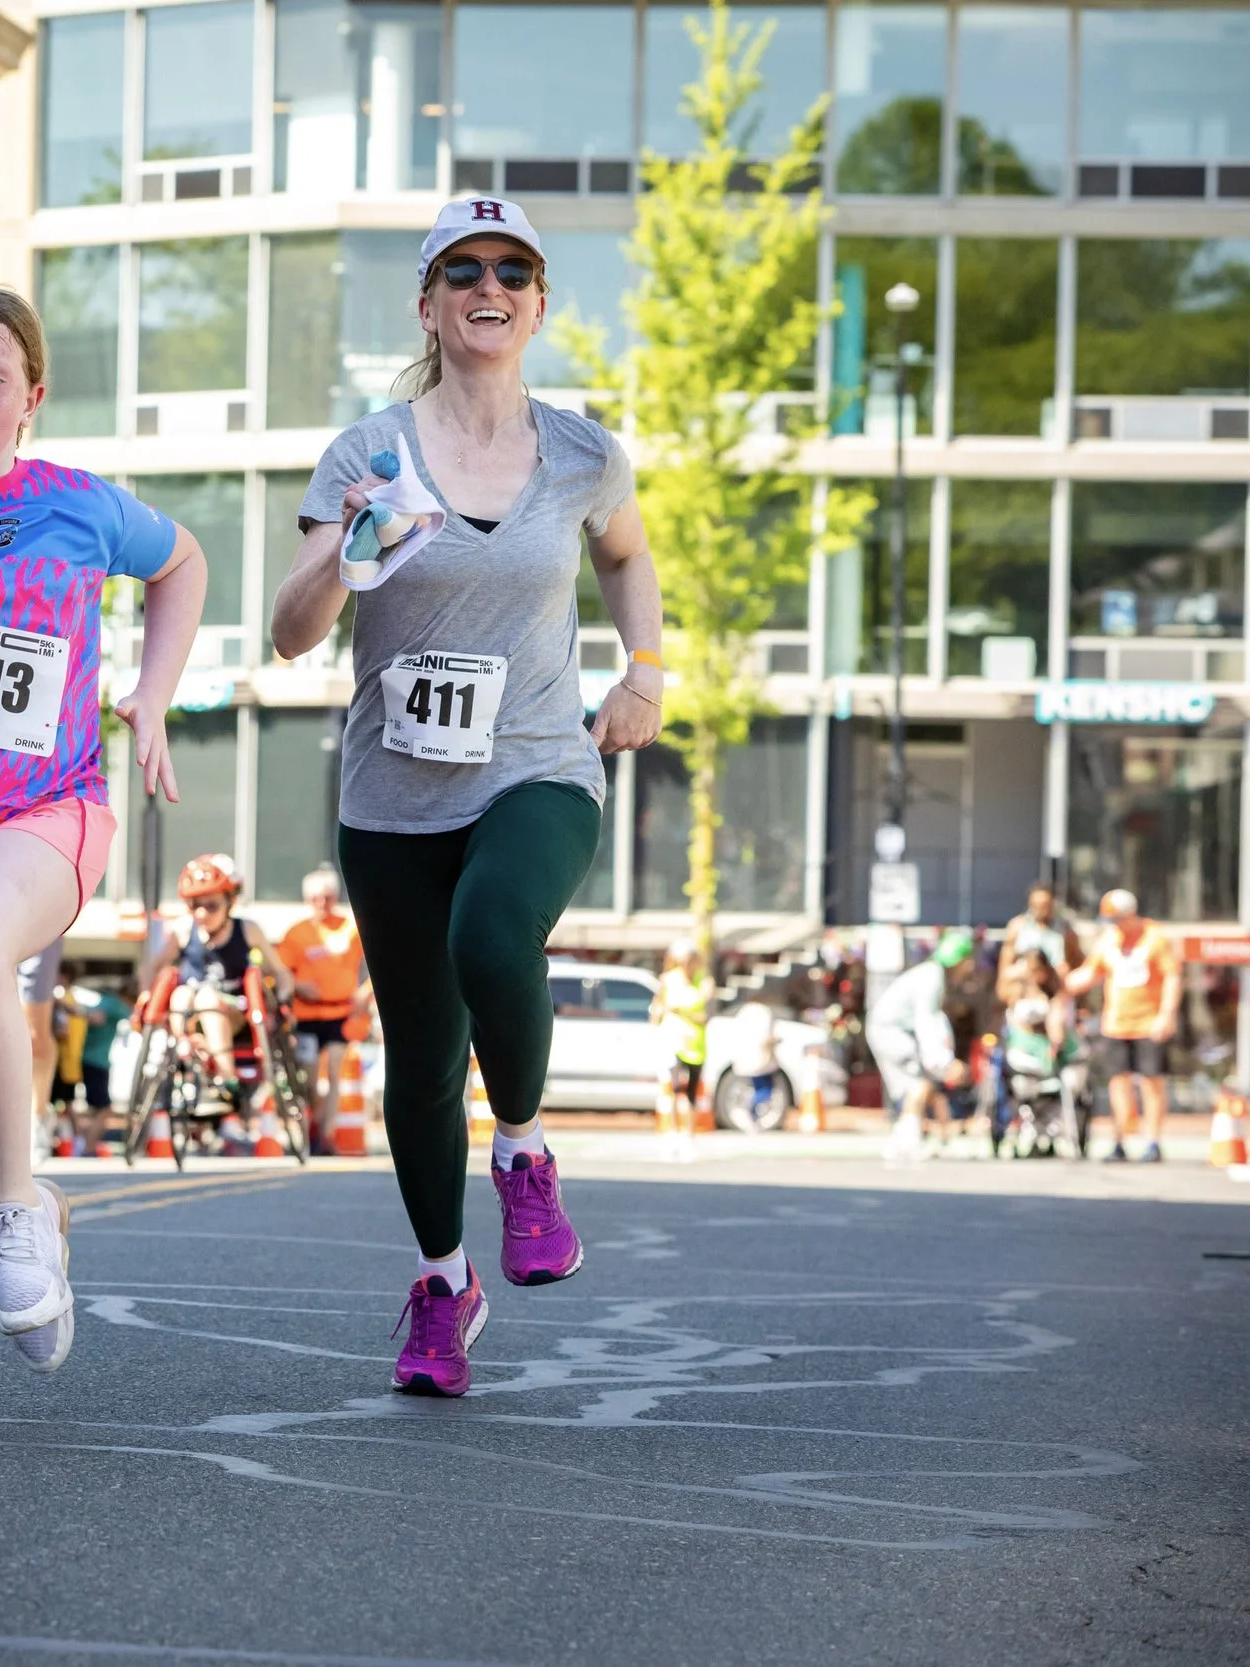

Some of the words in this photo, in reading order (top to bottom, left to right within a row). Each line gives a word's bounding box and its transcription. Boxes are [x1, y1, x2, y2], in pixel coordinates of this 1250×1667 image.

[470, 201, 506, 224] H
[406, 678, 476, 729] 411
[14, 738, 45, 751] DRINK
[389, 737, 409, 749] FOOD
[421, 746, 449, 757] DRINK
[464, 750, 486, 758] DRINK
